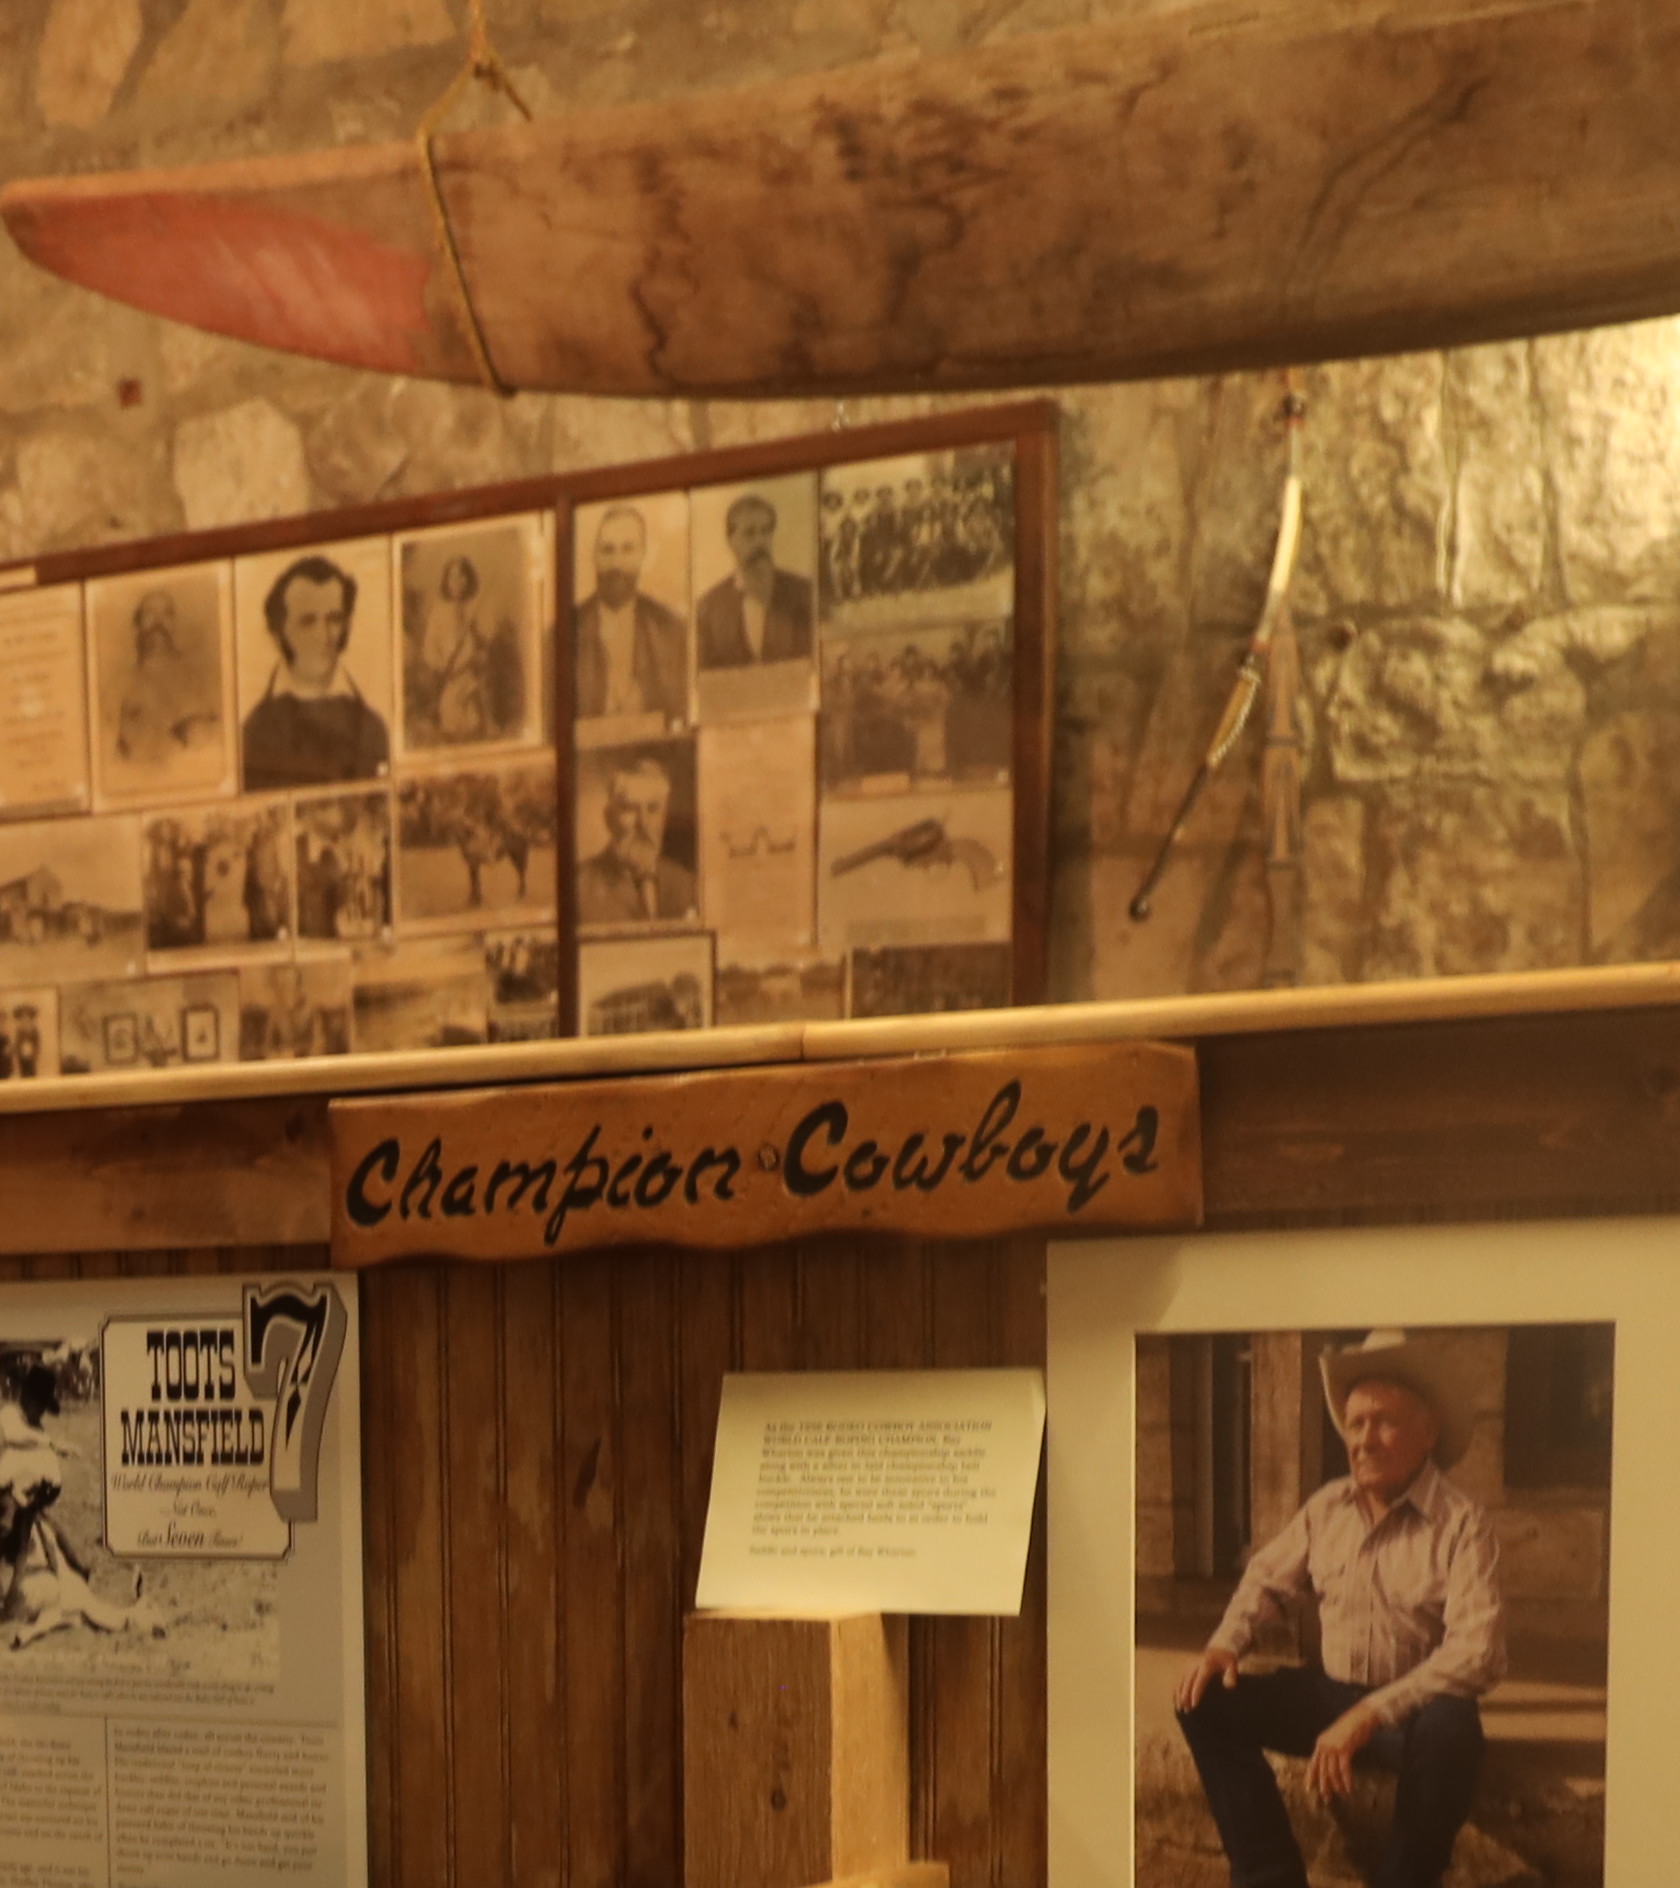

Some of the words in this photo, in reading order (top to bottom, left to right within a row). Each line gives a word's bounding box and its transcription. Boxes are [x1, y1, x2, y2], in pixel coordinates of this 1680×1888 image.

[345, 1122, 742, 1245] Champion
[781, 1078, 1160, 1212] Cowboys
[147, 1330, 236, 1401] TOOTS
[242, 1280, 348, 1523] 7
[121, 1408, 265, 1466] MANSFIELD
[148, 1473, 202, 1497] Champion
[166, 1520, 205, 1547] Seven
